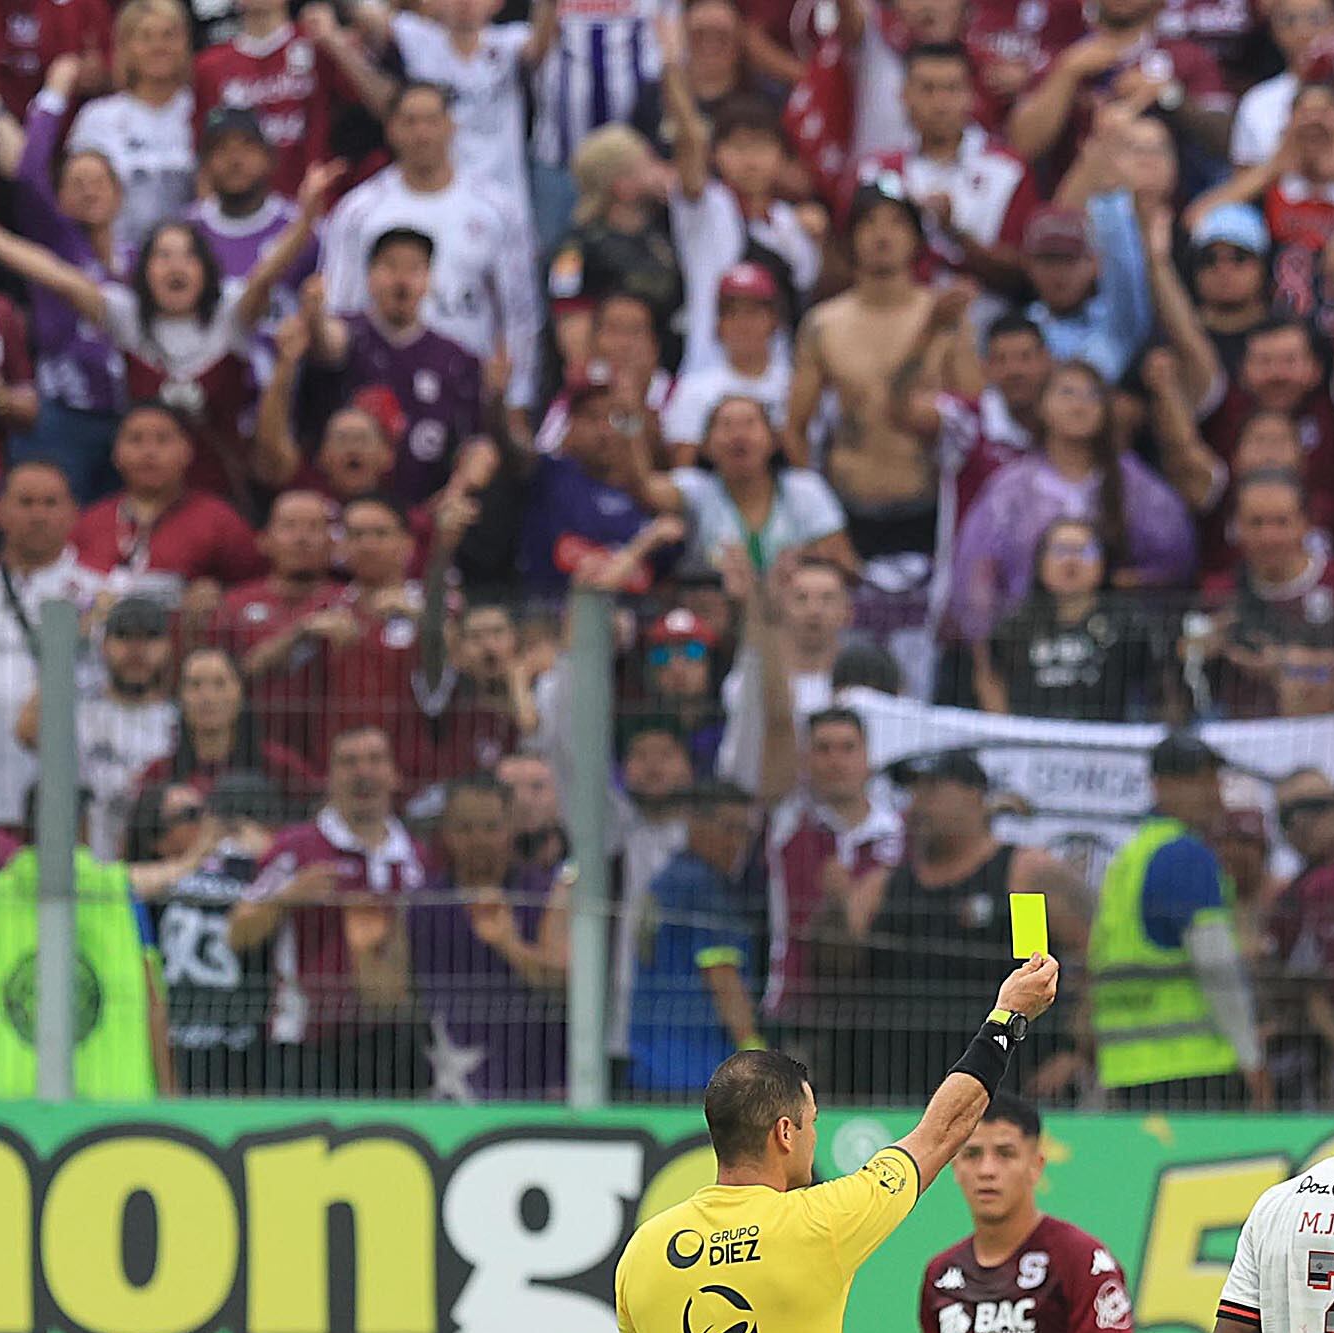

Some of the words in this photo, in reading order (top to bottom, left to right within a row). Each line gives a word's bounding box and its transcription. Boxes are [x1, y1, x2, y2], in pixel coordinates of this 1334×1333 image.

[1296, 1175, 1330, 1194] Dos
[709, 1224, 760, 1244] GRUPO
[709, 1239, 762, 1267] DIEZ
[975, 1297, 1038, 1332] BAC
